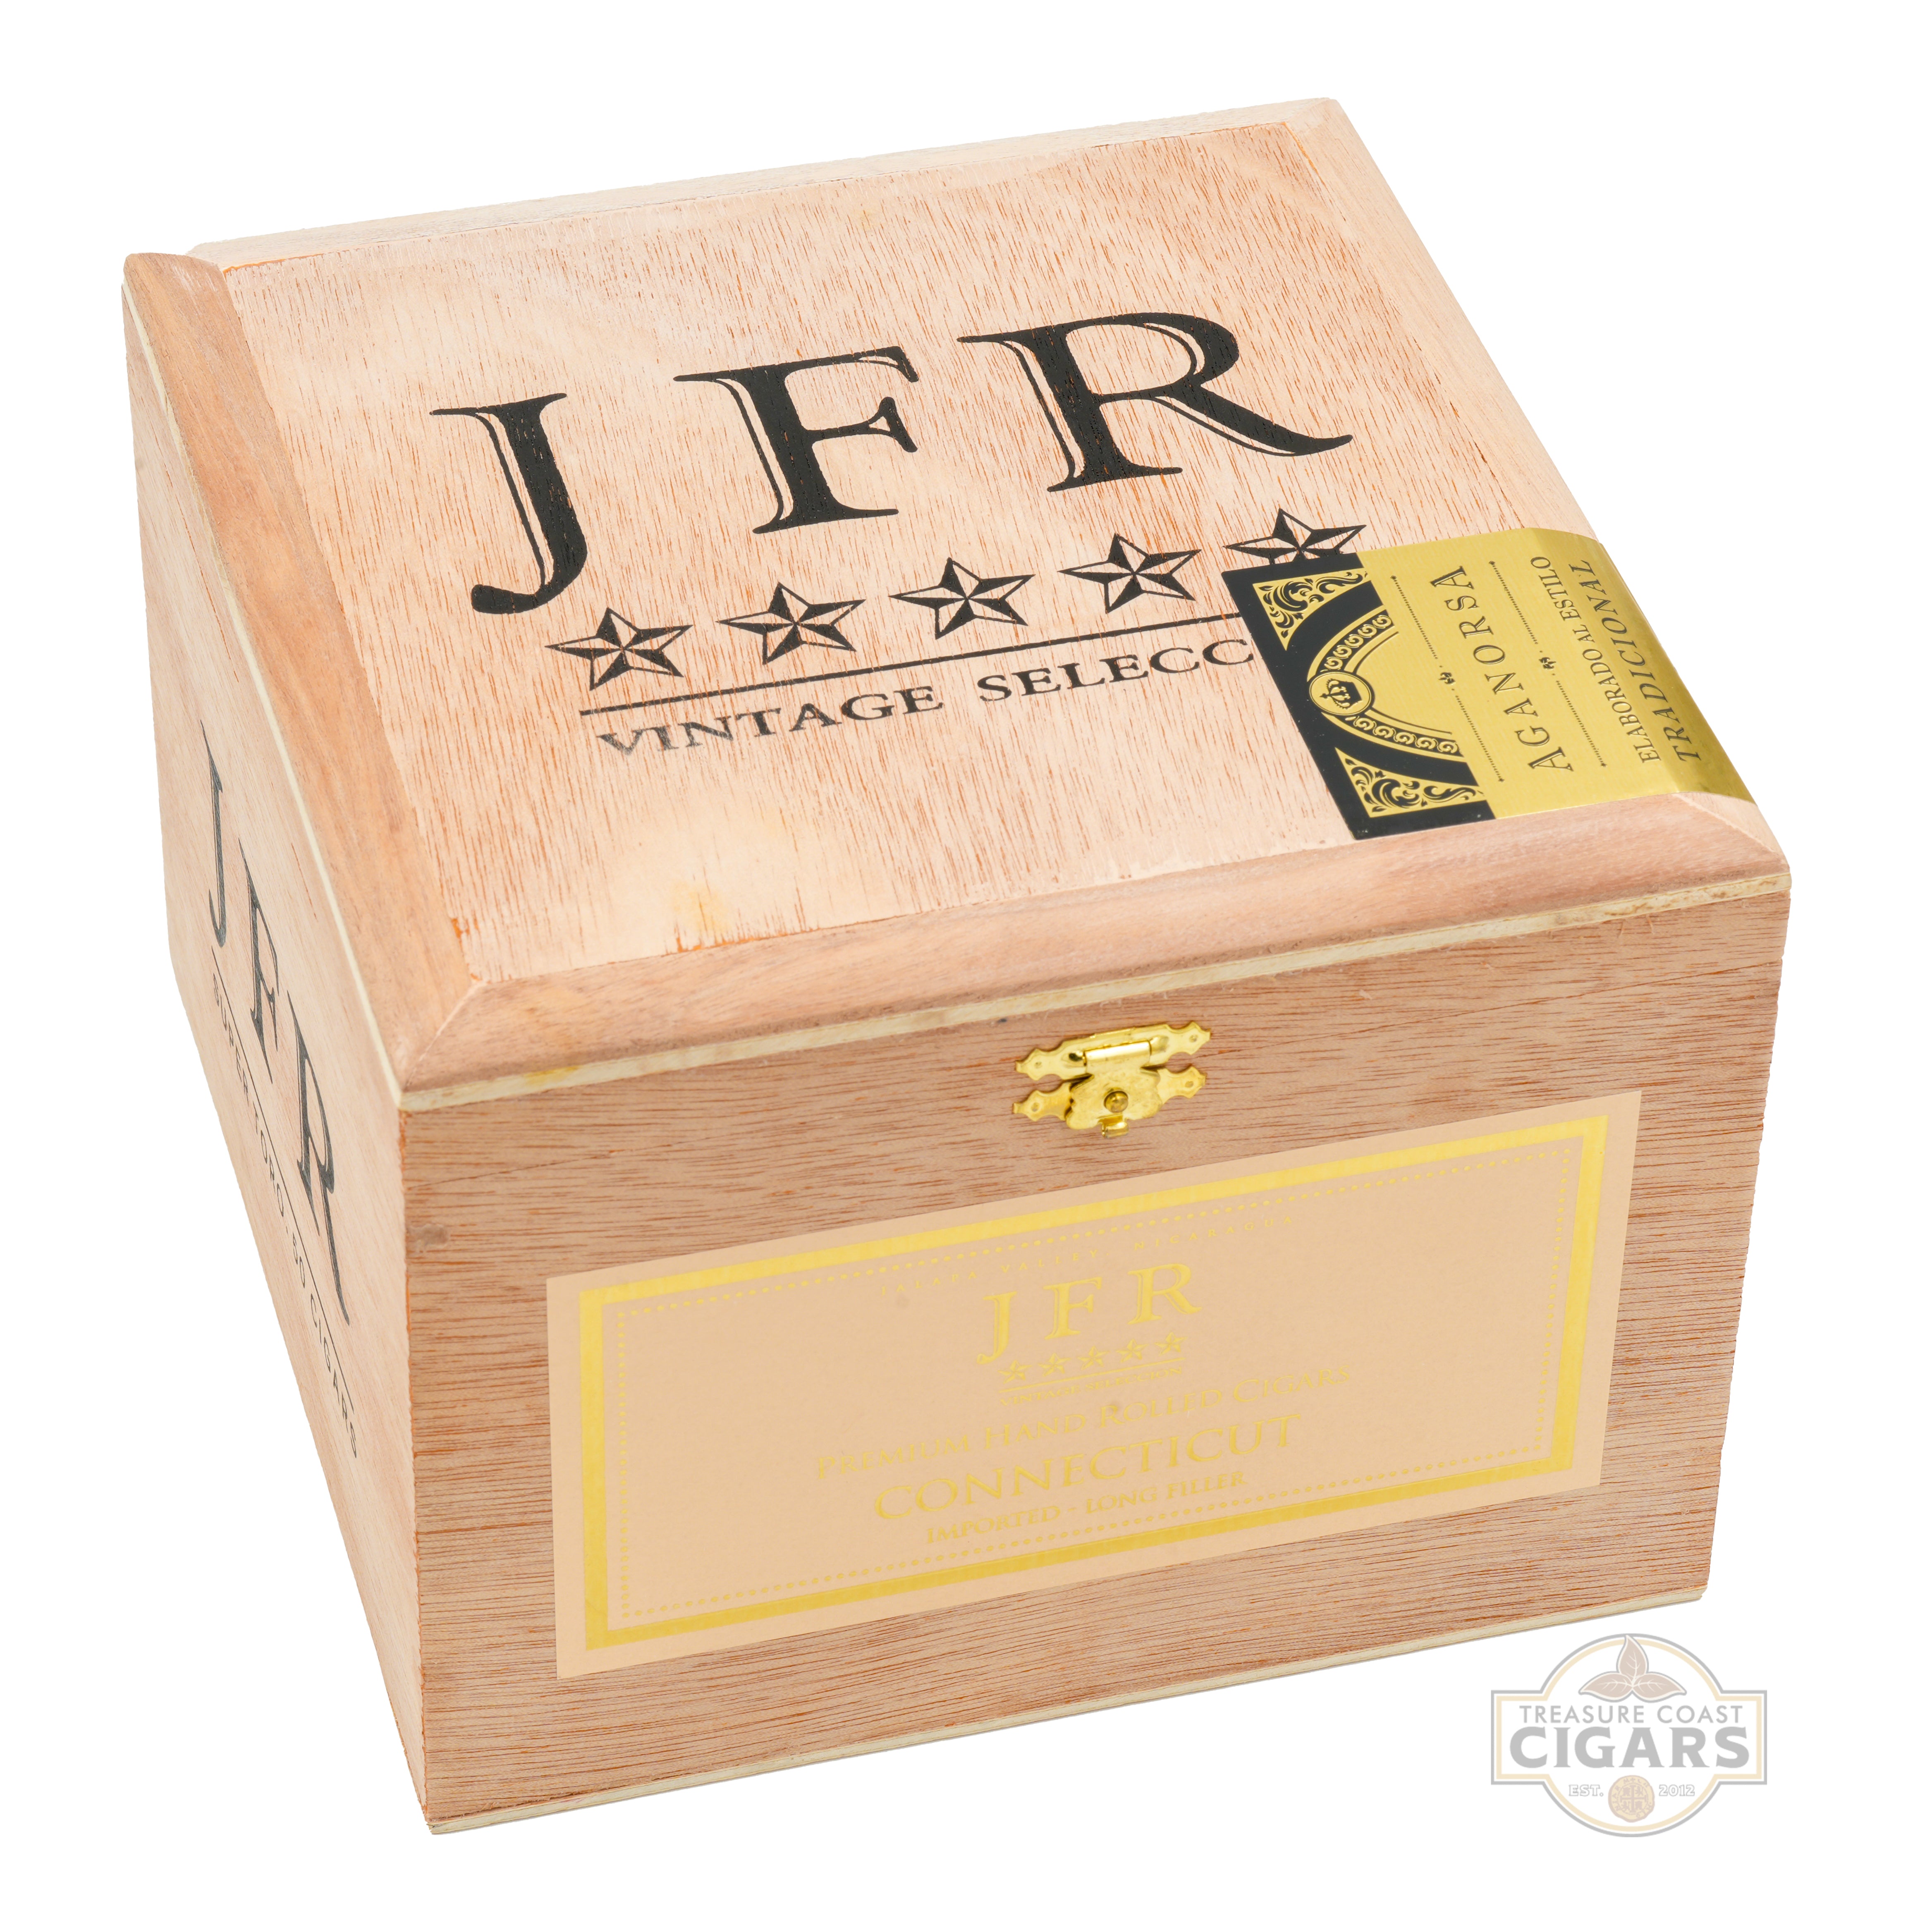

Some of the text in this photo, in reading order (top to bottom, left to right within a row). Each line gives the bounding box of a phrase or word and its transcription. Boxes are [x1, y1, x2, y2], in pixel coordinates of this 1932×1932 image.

[429, 311, 1353, 615] JFR
[1430, 564, 1574, 772] AGANORSA
[1530, 556, 1661, 763] ELABORADO AL ESTILO
[1568, 560, 1701, 761] TRADICIONAL
[596, 684, 943, 755] VINTAGE
[213, 973, 249, 1107] SUPER
[253, 1100, 284, 1217] TORO
[311, 1293, 356, 1459] CIGARS
[881, 1271, 977, 1296] JALAPA
[1133, 1216, 1292, 1251] NICARAGUA
[976, 1263, 1202, 1364] JFR
[1000, 1385, 1080, 1406] VINTAGE
[874, 1414, 1301, 1520] CONNECTICUT
[927, 1505, 1060, 1543] IMPORTED
[1086, 1489, 1157, 1514] LONG
[1166, 1471, 1246, 1500] FILLER
